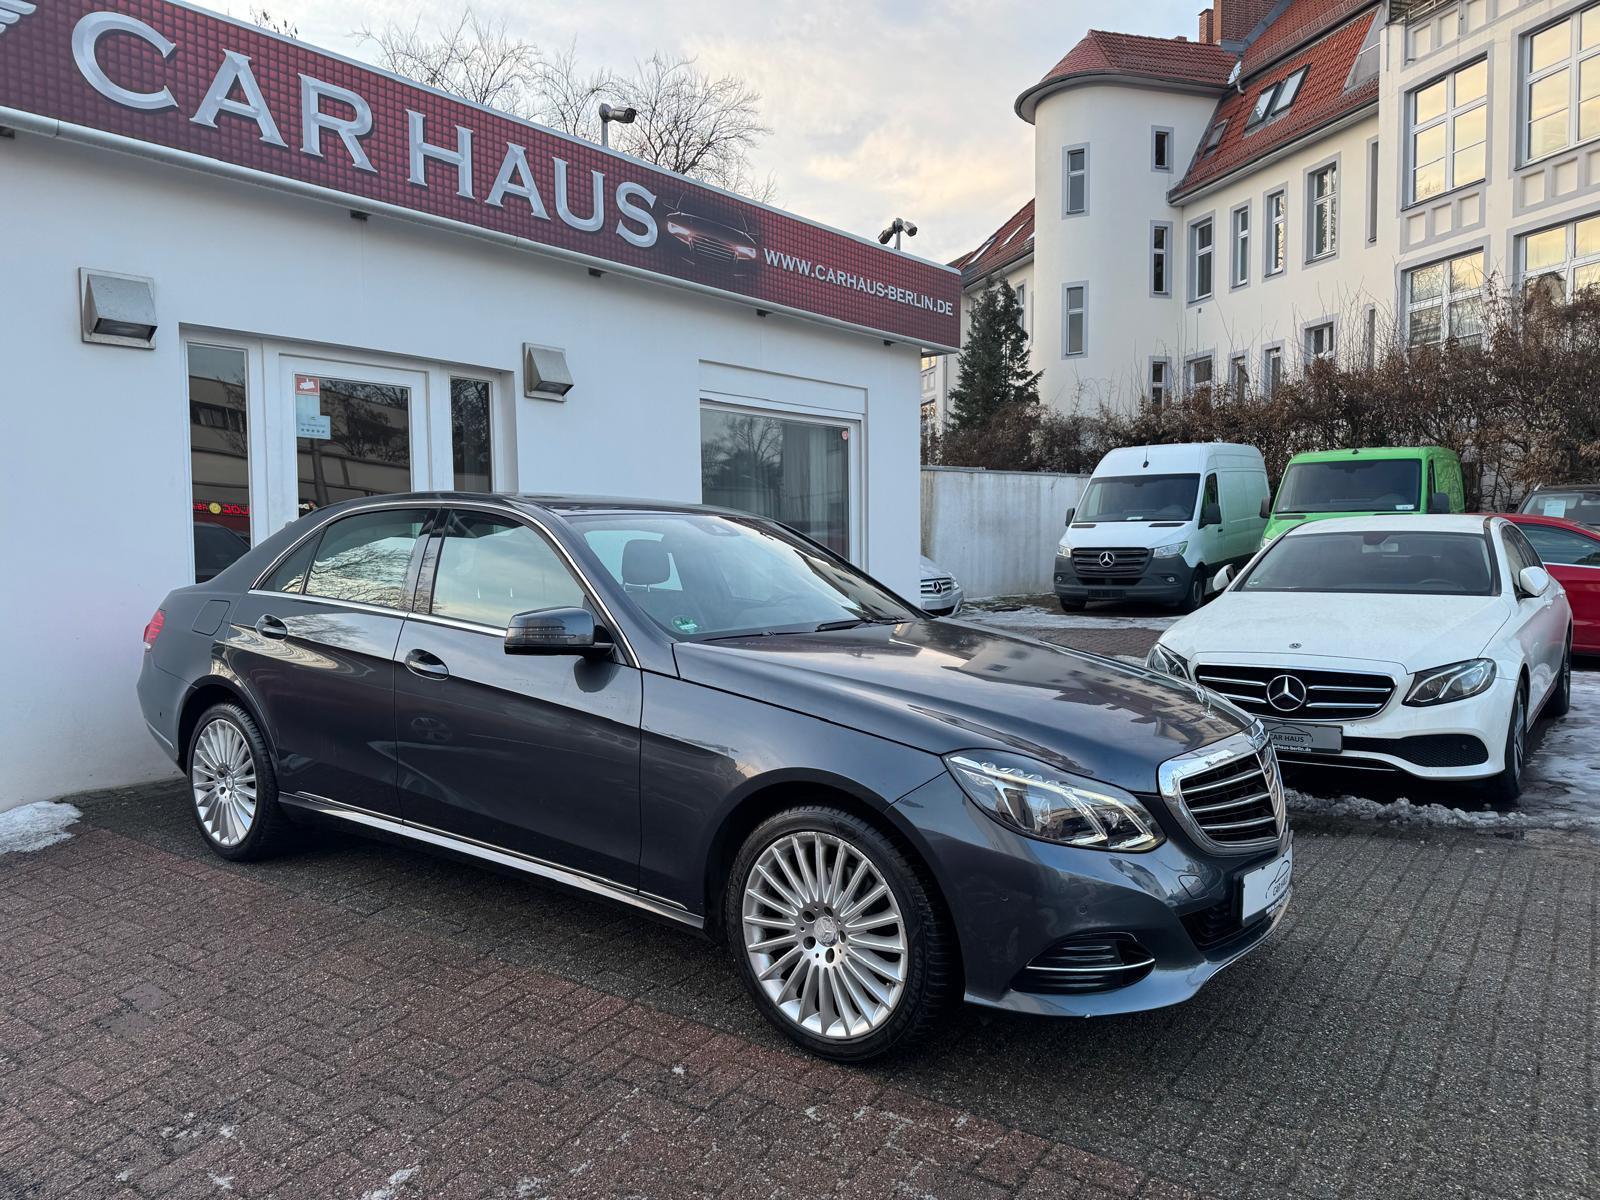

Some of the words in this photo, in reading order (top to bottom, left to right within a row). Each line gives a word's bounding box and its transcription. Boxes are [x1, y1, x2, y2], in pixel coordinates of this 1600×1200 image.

[71, 11, 378, 173] CAR
[405, 109, 658, 247] HAUS
[764, 248, 953, 316] WWW.CARHAUS-BERLIN.DE
[1284, 735, 1305, 743] HAUS
